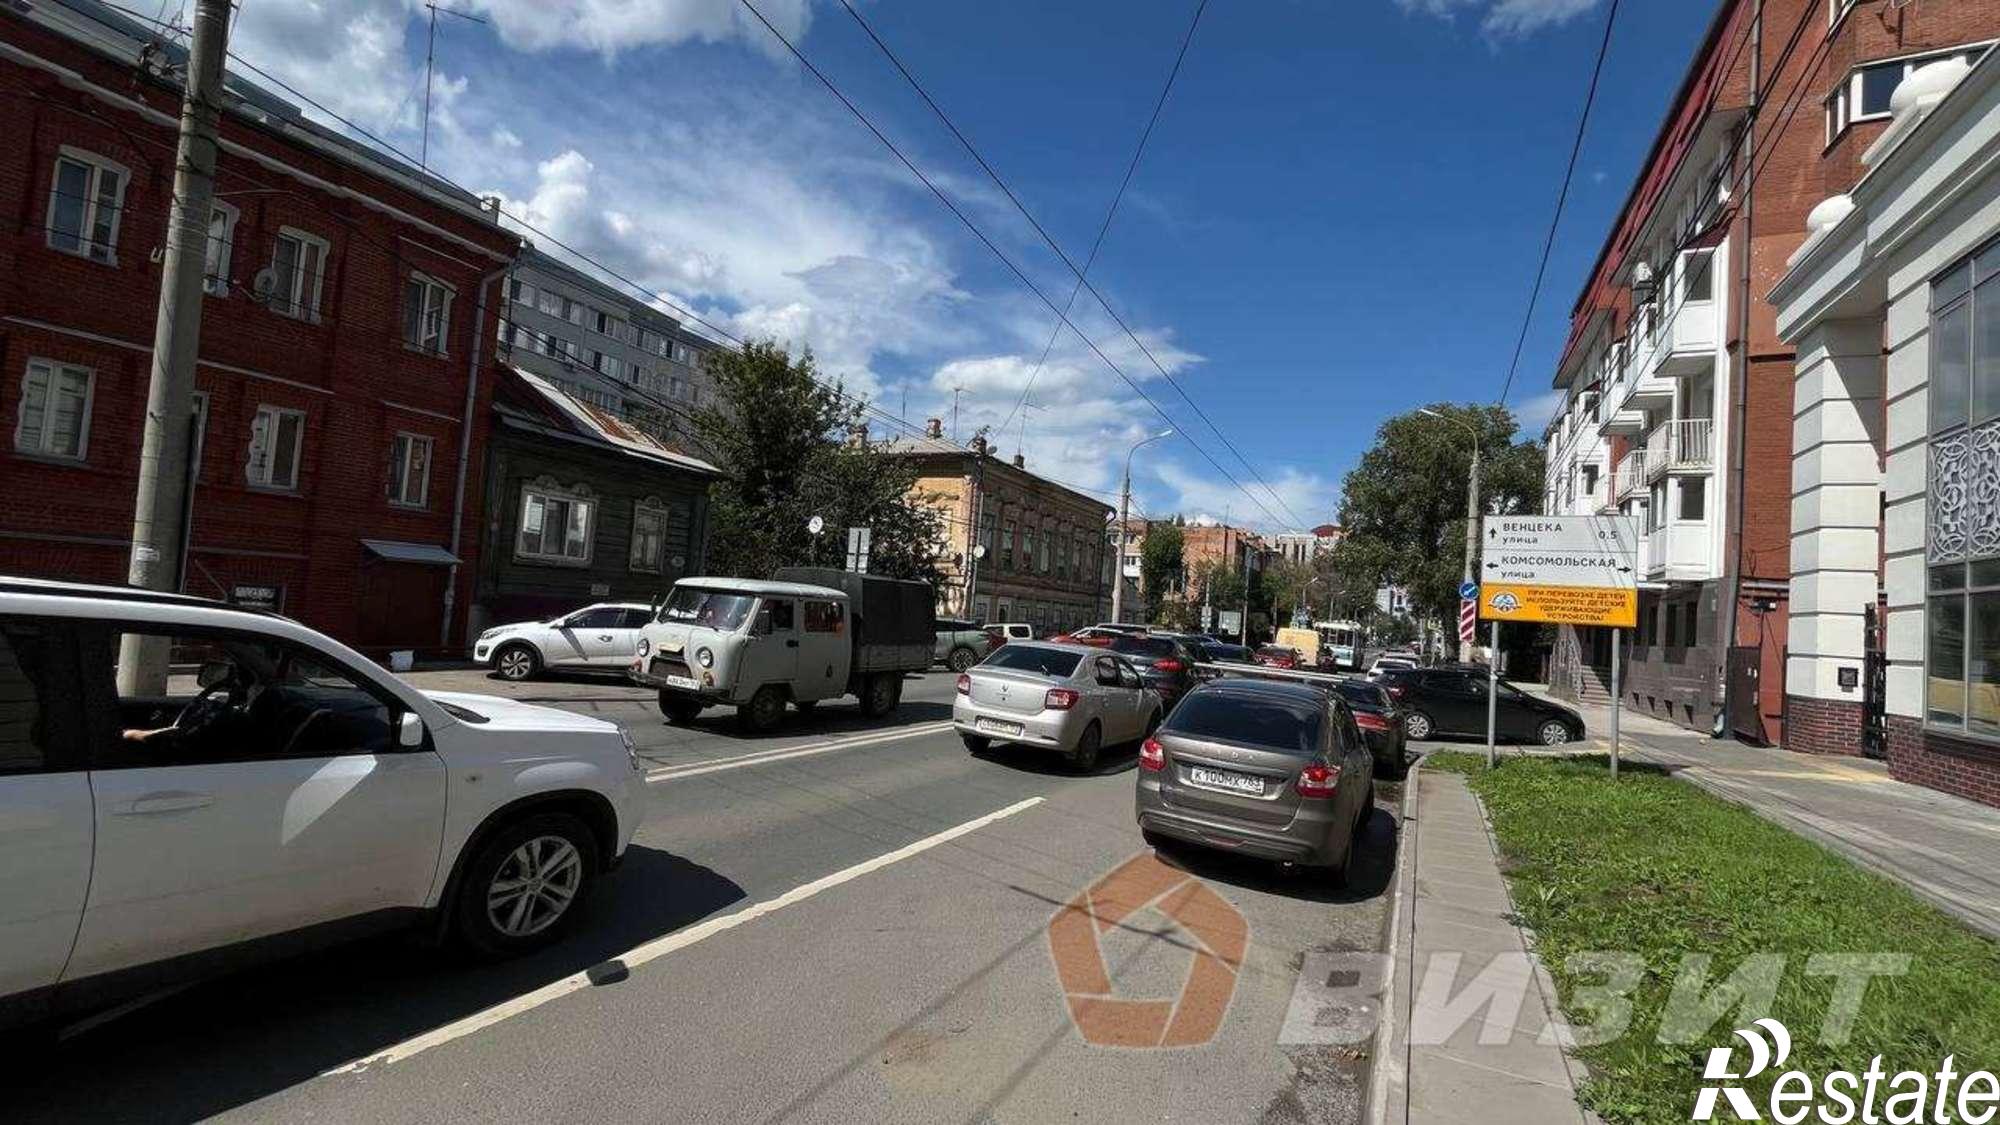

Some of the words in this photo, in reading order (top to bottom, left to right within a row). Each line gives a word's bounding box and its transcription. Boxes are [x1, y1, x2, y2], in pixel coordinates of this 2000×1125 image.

[1503, 523, 1562, 532] ВЕНЦЕКА
[1501, 556, 1617, 568] КОМСОМОЛЬСКАЯ
[1501, 570, 1535, 579] улица
